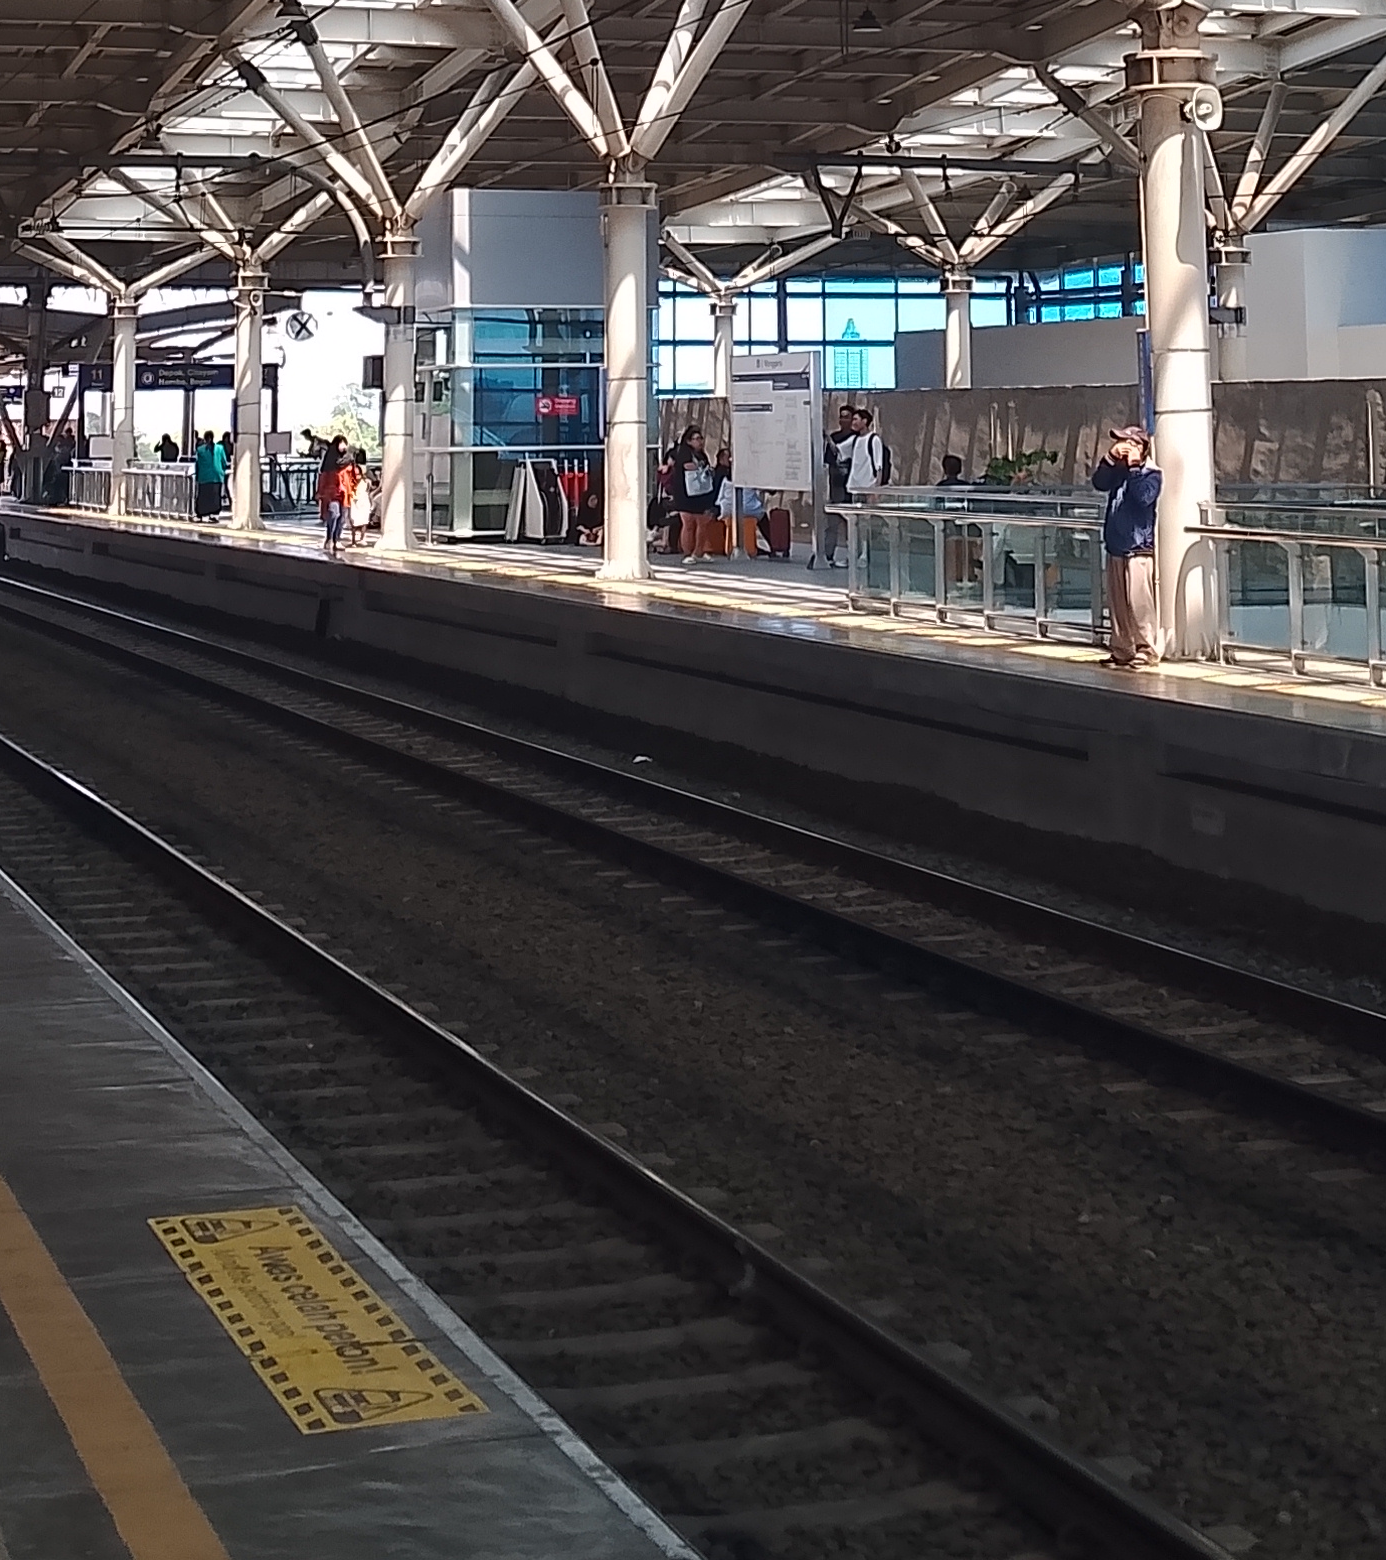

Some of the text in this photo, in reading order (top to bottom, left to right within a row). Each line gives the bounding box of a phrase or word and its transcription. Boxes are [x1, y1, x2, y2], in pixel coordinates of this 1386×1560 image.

[91, 369, 103, 380] 11
[53, 389, 64, 397] 12
[247, 1245, 304, 1283] Awas
[280, 1283, 349, 1322] celah
